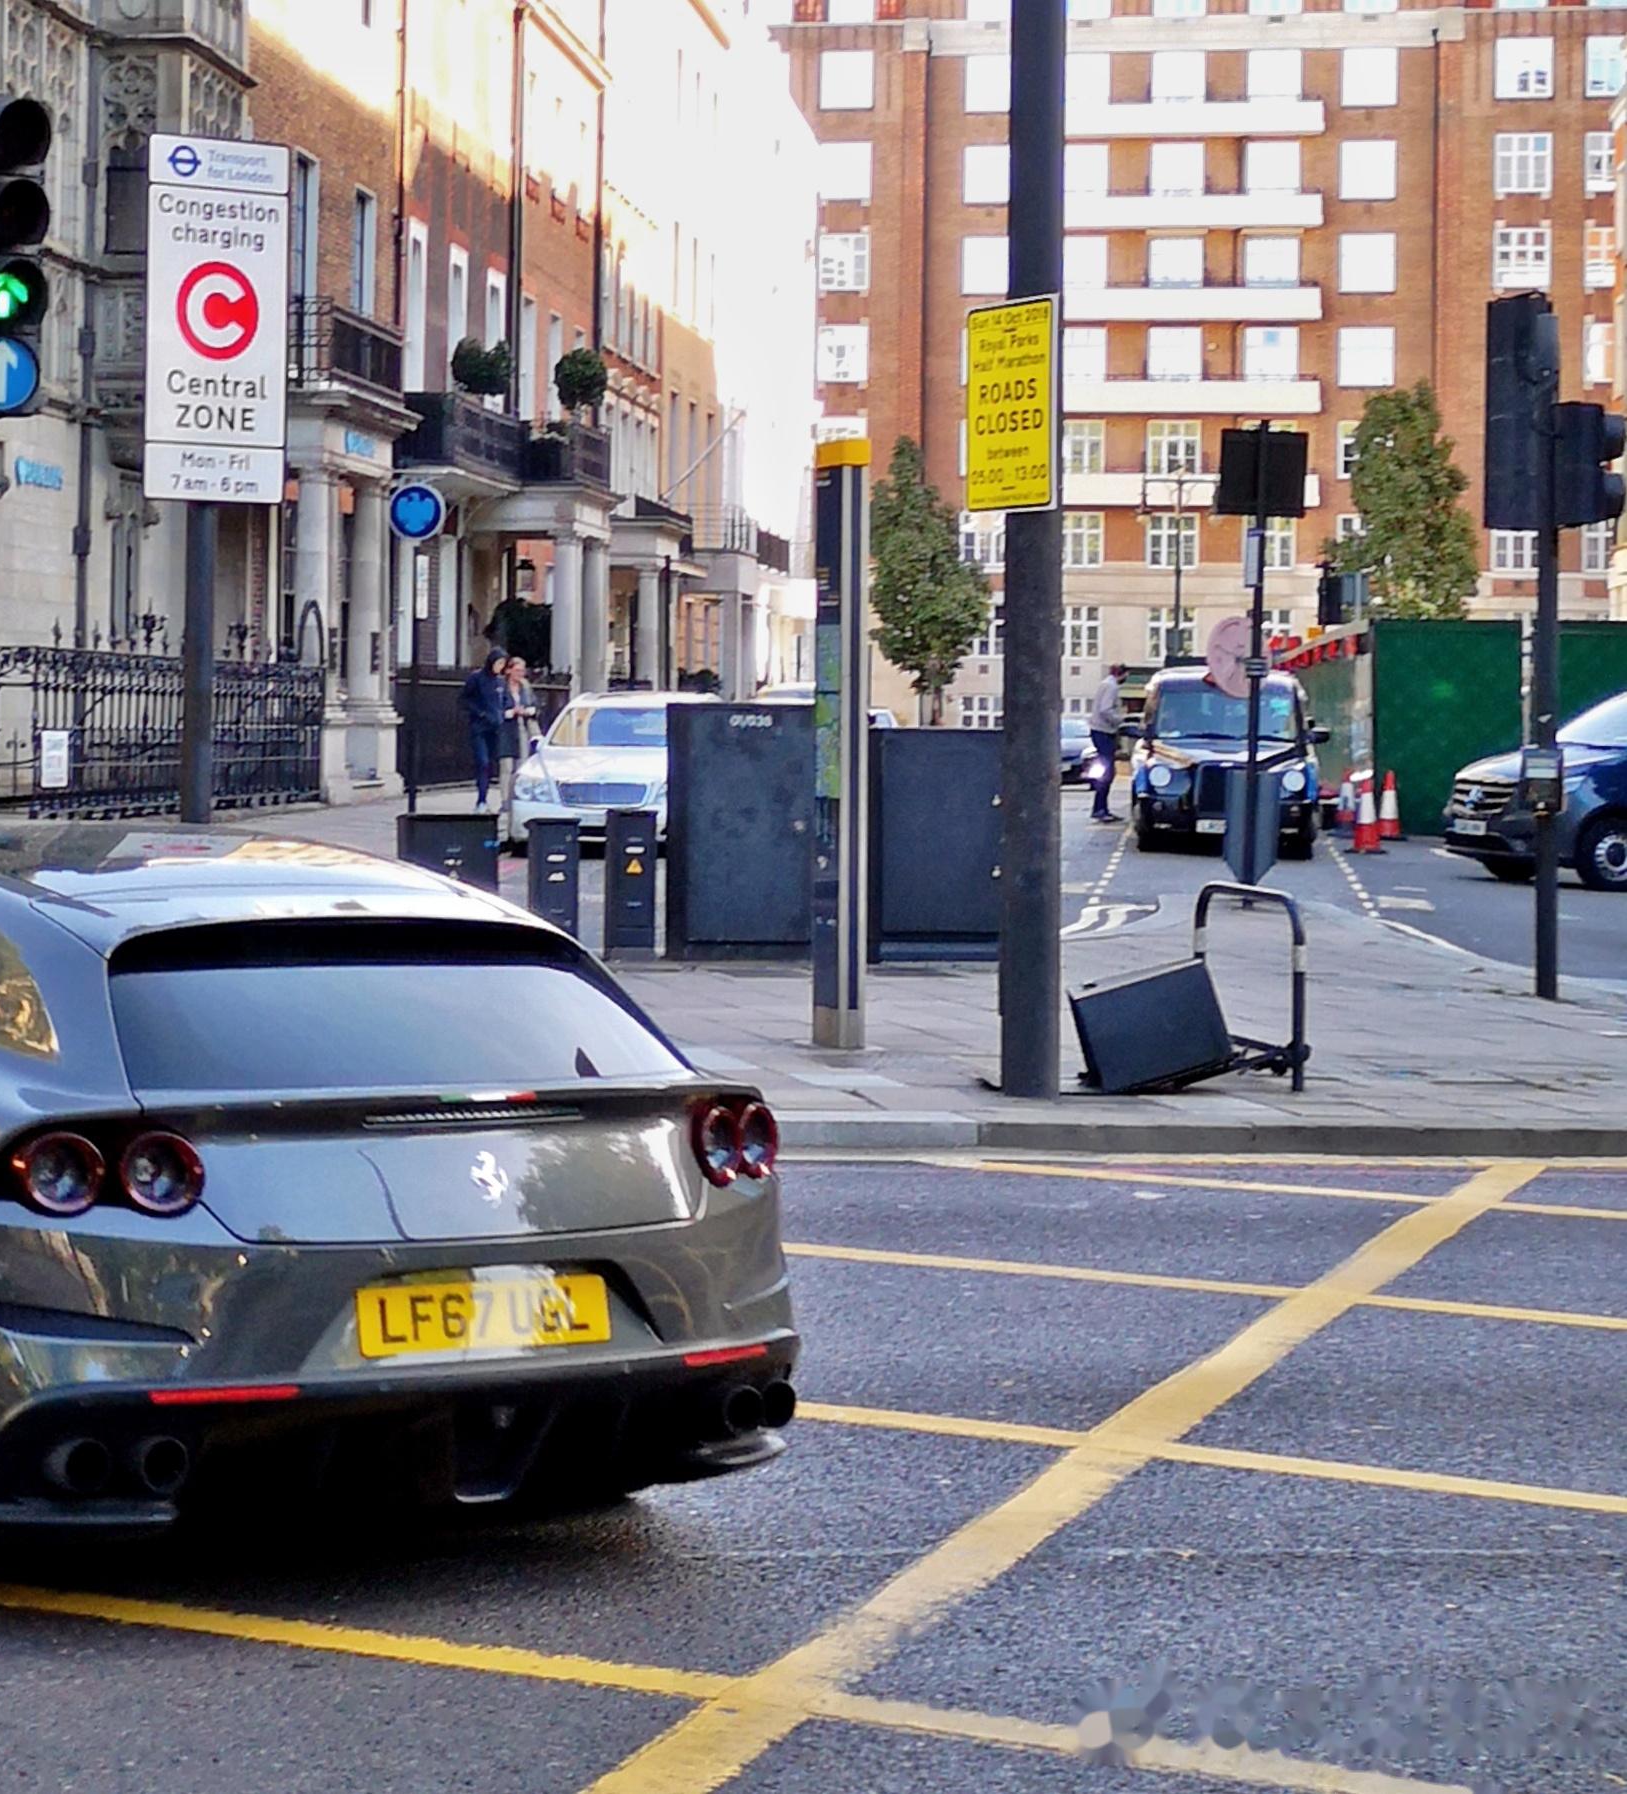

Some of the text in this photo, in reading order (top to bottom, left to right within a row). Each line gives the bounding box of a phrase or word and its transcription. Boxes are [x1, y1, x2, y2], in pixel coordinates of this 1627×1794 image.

[207, 149, 268, 167] Transport
[207, 165, 274, 183] for London
[158, 193, 280, 223] Congestion
[171, 222, 265, 252] charging
[1009, 333, 1040, 349] Parks
[167, 369, 268, 400] Central
[978, 377, 1038, 405] ROADS
[175, 404, 256, 432] ZONE
[974, 407, 1045, 437] CLOSED
[180, 451, 217, 468] Mon
[229, 453, 251, 471] Fri
[987, 445, 1030, 461] between
[378, 1285, 590, 1344] LF67 UGL
